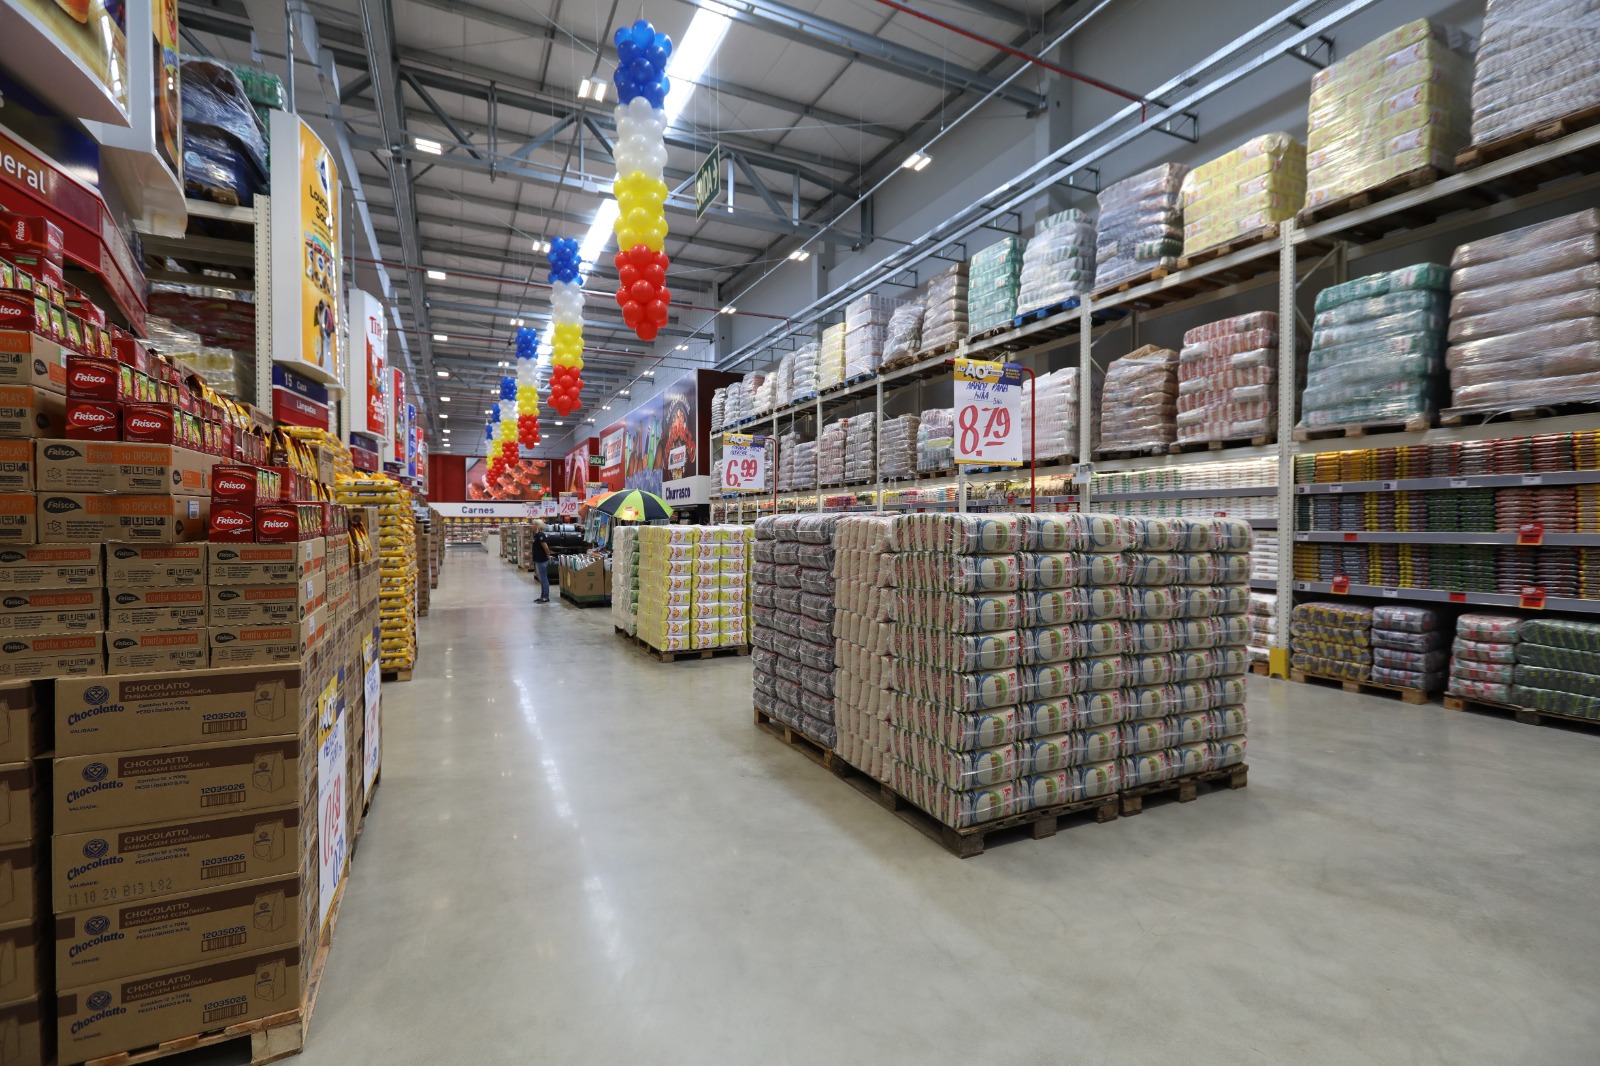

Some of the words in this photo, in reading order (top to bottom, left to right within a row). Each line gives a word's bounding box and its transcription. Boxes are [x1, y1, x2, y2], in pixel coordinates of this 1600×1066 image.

[0, 337, 23, 348] PLAYS
[284, 373, 293, 388] 15
[1, 392, 25, 403] PLAYS
[134, 451, 168, 462] DISPLAYS
[666, 487, 690, 500] Churrasco
[132, 501, 167, 511] DISPLAYS
[461, 506, 495, 514] Carnes
[125, 682, 190, 692] CHOCOLATTO
[68, 704, 125, 726] Chocolatto
[202, 711, 247, 720] 12035026
[123, 756, 189, 769] CHOCOLATTO
[123, 766, 168, 776] EMBALAGEM
[66, 780, 124, 804] Chocolatto
[201, 783, 245, 795] 12035026
[124, 828, 189, 844] CHOCOLATTO
[124, 840, 168, 851] EMBALAGEM
[201, 854, 245, 866] 12035026
[67, 856, 124, 881] Chocolatto
[68, 893, 78, 907] 11
[125, 902, 190, 919] CHOCOLATTO
[125, 914, 169, 926] EMBALAGEM
[202, 925, 246, 940] 12035026
[69, 932, 125, 958] Chocolatto
[127, 974, 191, 994] CHOCOLATTO
[126, 987, 170, 1001] EMBALAGEM
[204, 995, 247, 1010] 12035026
[71, 1006, 127, 1034] Chocolatto
